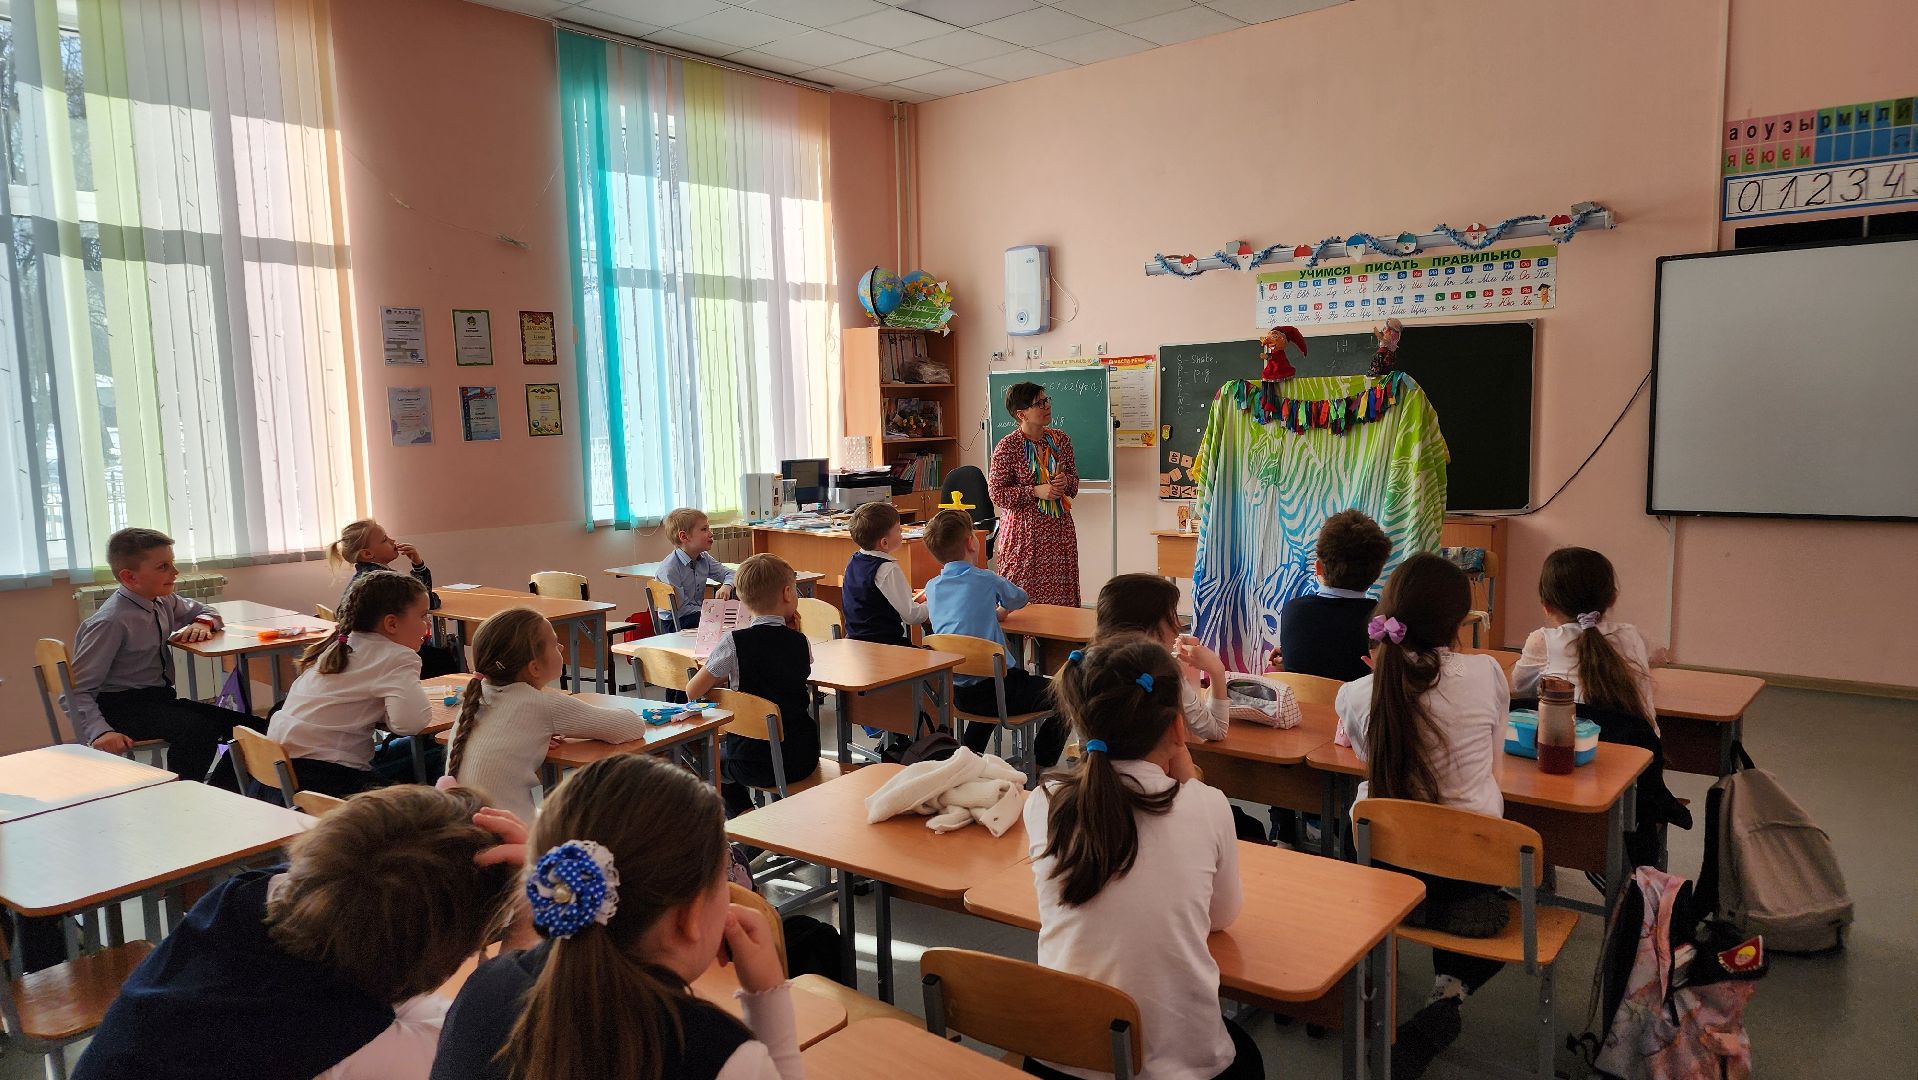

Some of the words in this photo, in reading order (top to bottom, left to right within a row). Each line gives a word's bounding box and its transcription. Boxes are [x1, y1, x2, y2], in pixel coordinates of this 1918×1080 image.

[1738, 180, 1760, 212] 0
[1779, 175, 1798, 209] 1
[1805, 172, 1832, 206] 2
[1840, 168, 1868, 202] 3
[1884, 163, 1904, 198] 4
[1300, 266, 1350, 279] УЧИМСЯ
[1365, 260, 1418, 272] ПИСАТЬ
[1432, 249, 1521, 266] ПРАВИЛЬНО
